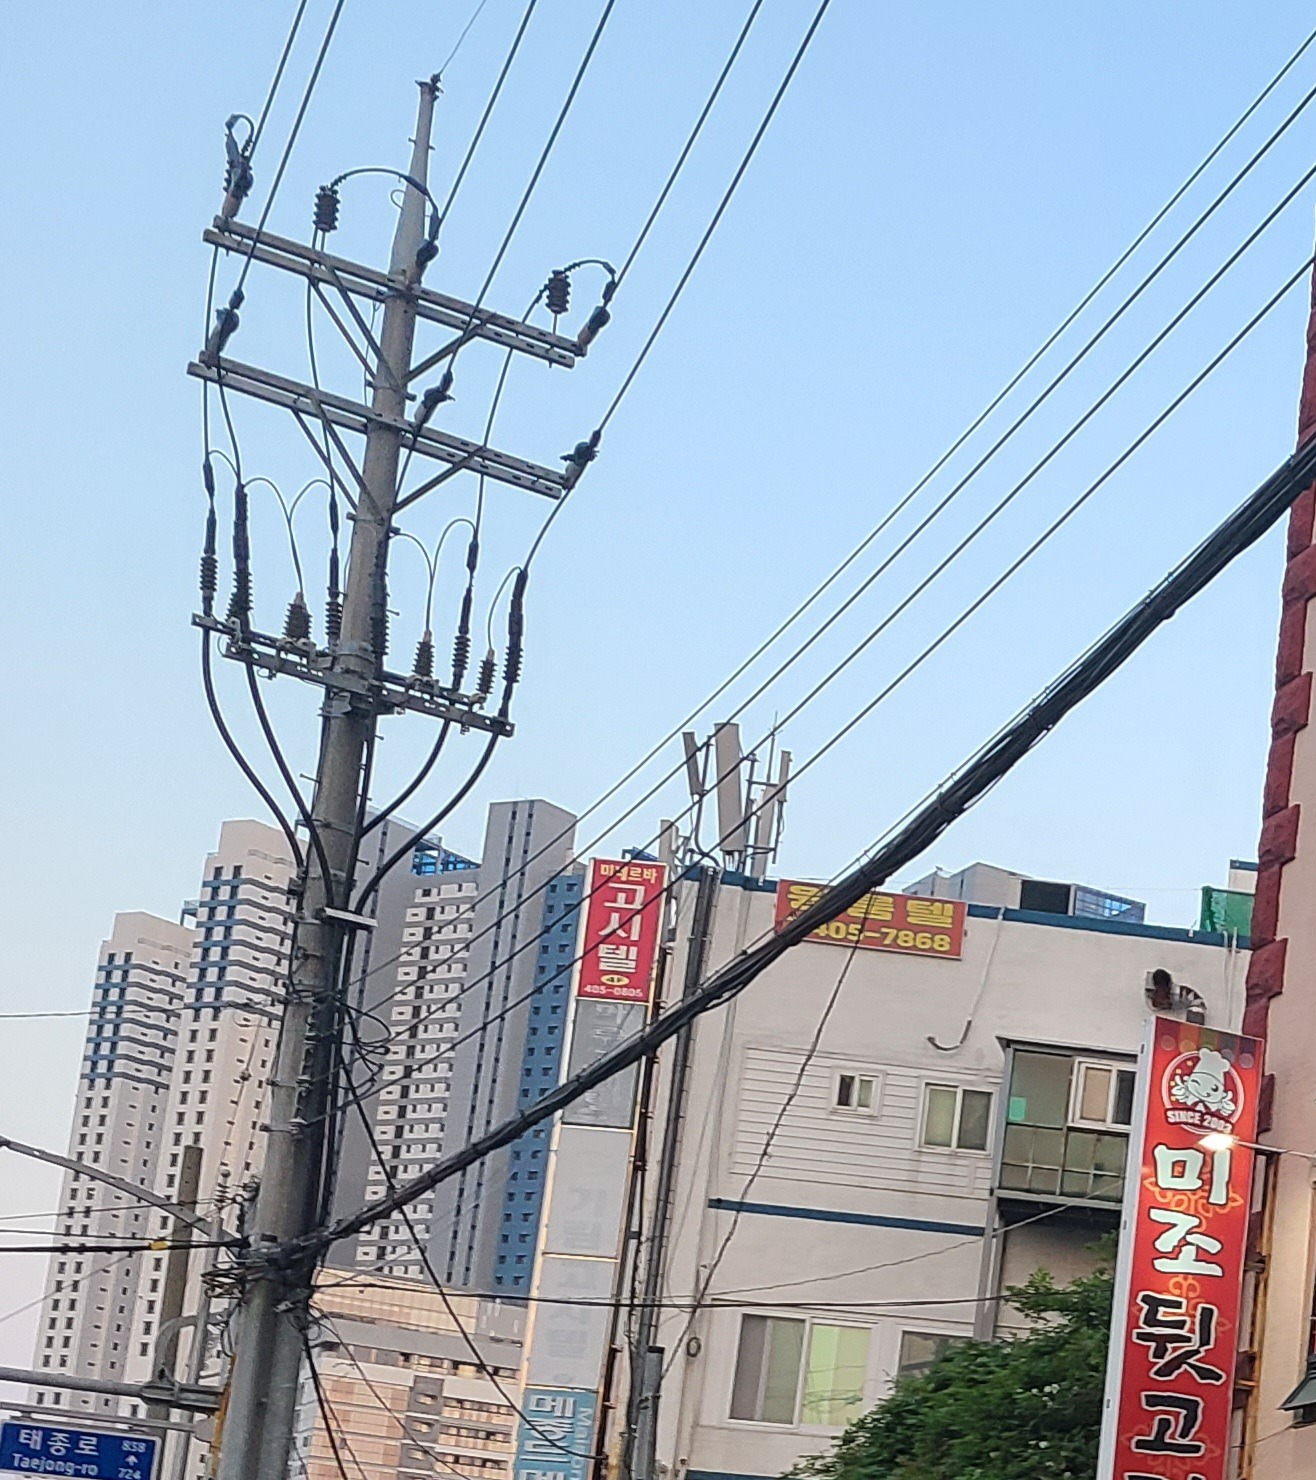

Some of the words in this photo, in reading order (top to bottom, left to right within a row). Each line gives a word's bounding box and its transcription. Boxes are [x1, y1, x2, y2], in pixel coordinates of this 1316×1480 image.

[598, 882, 645, 973] 고시텔
[1166, 1110, 1201, 1125] SINCE
[18, 1428, 99, 1457] 태종로
[12, 1452, 98, 1476] Taejong-ro
[118, 1467, 142, 1480] 724
